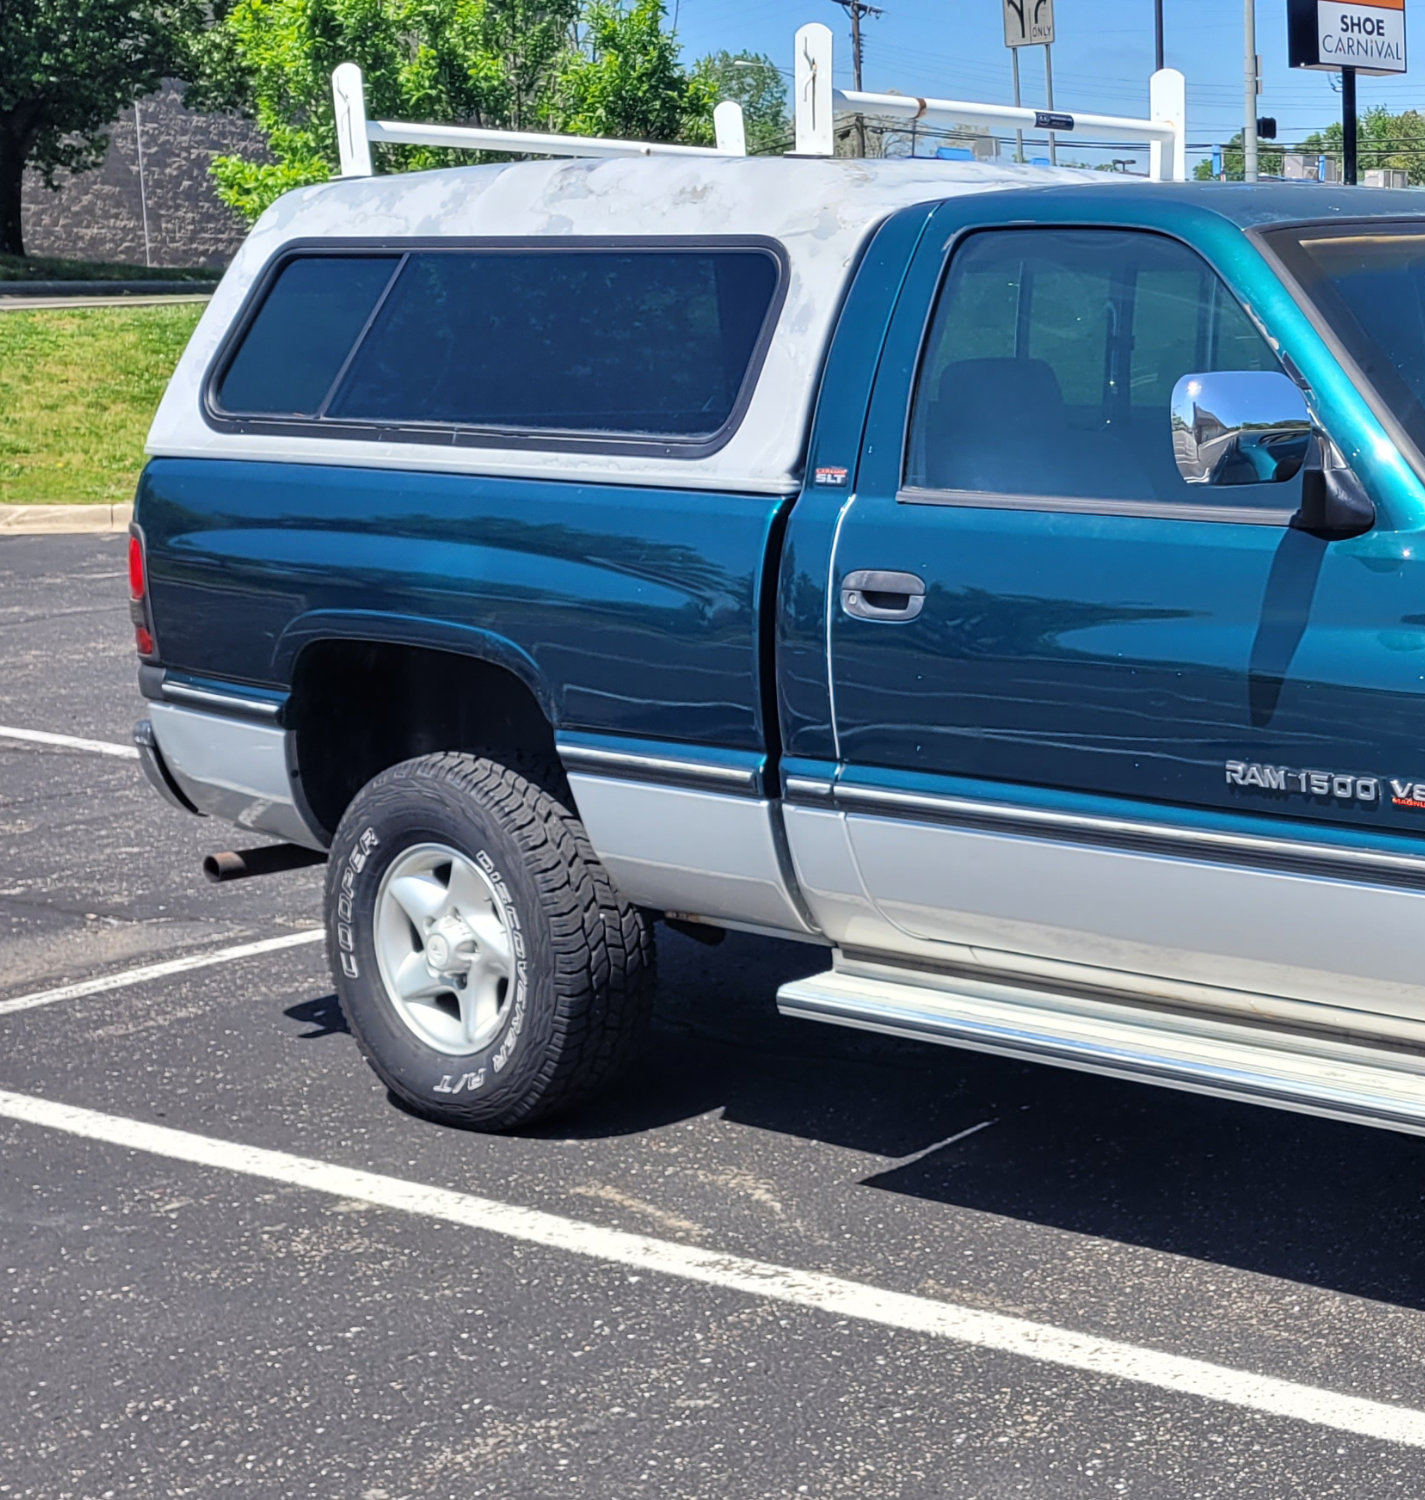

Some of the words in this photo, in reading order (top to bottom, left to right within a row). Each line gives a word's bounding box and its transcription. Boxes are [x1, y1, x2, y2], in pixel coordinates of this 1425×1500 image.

[1032, 26, 1051, 37] ONLY
[1340, 14, 1385, 37] SHOE
[815, 474, 846, 484] SLT
[1225, 760, 1286, 791] RAM
[1298, 771, 1380, 802] 1500
[335, 826, 380, 979] COOPER
[475, 849, 529, 1074] DISCOVERER
